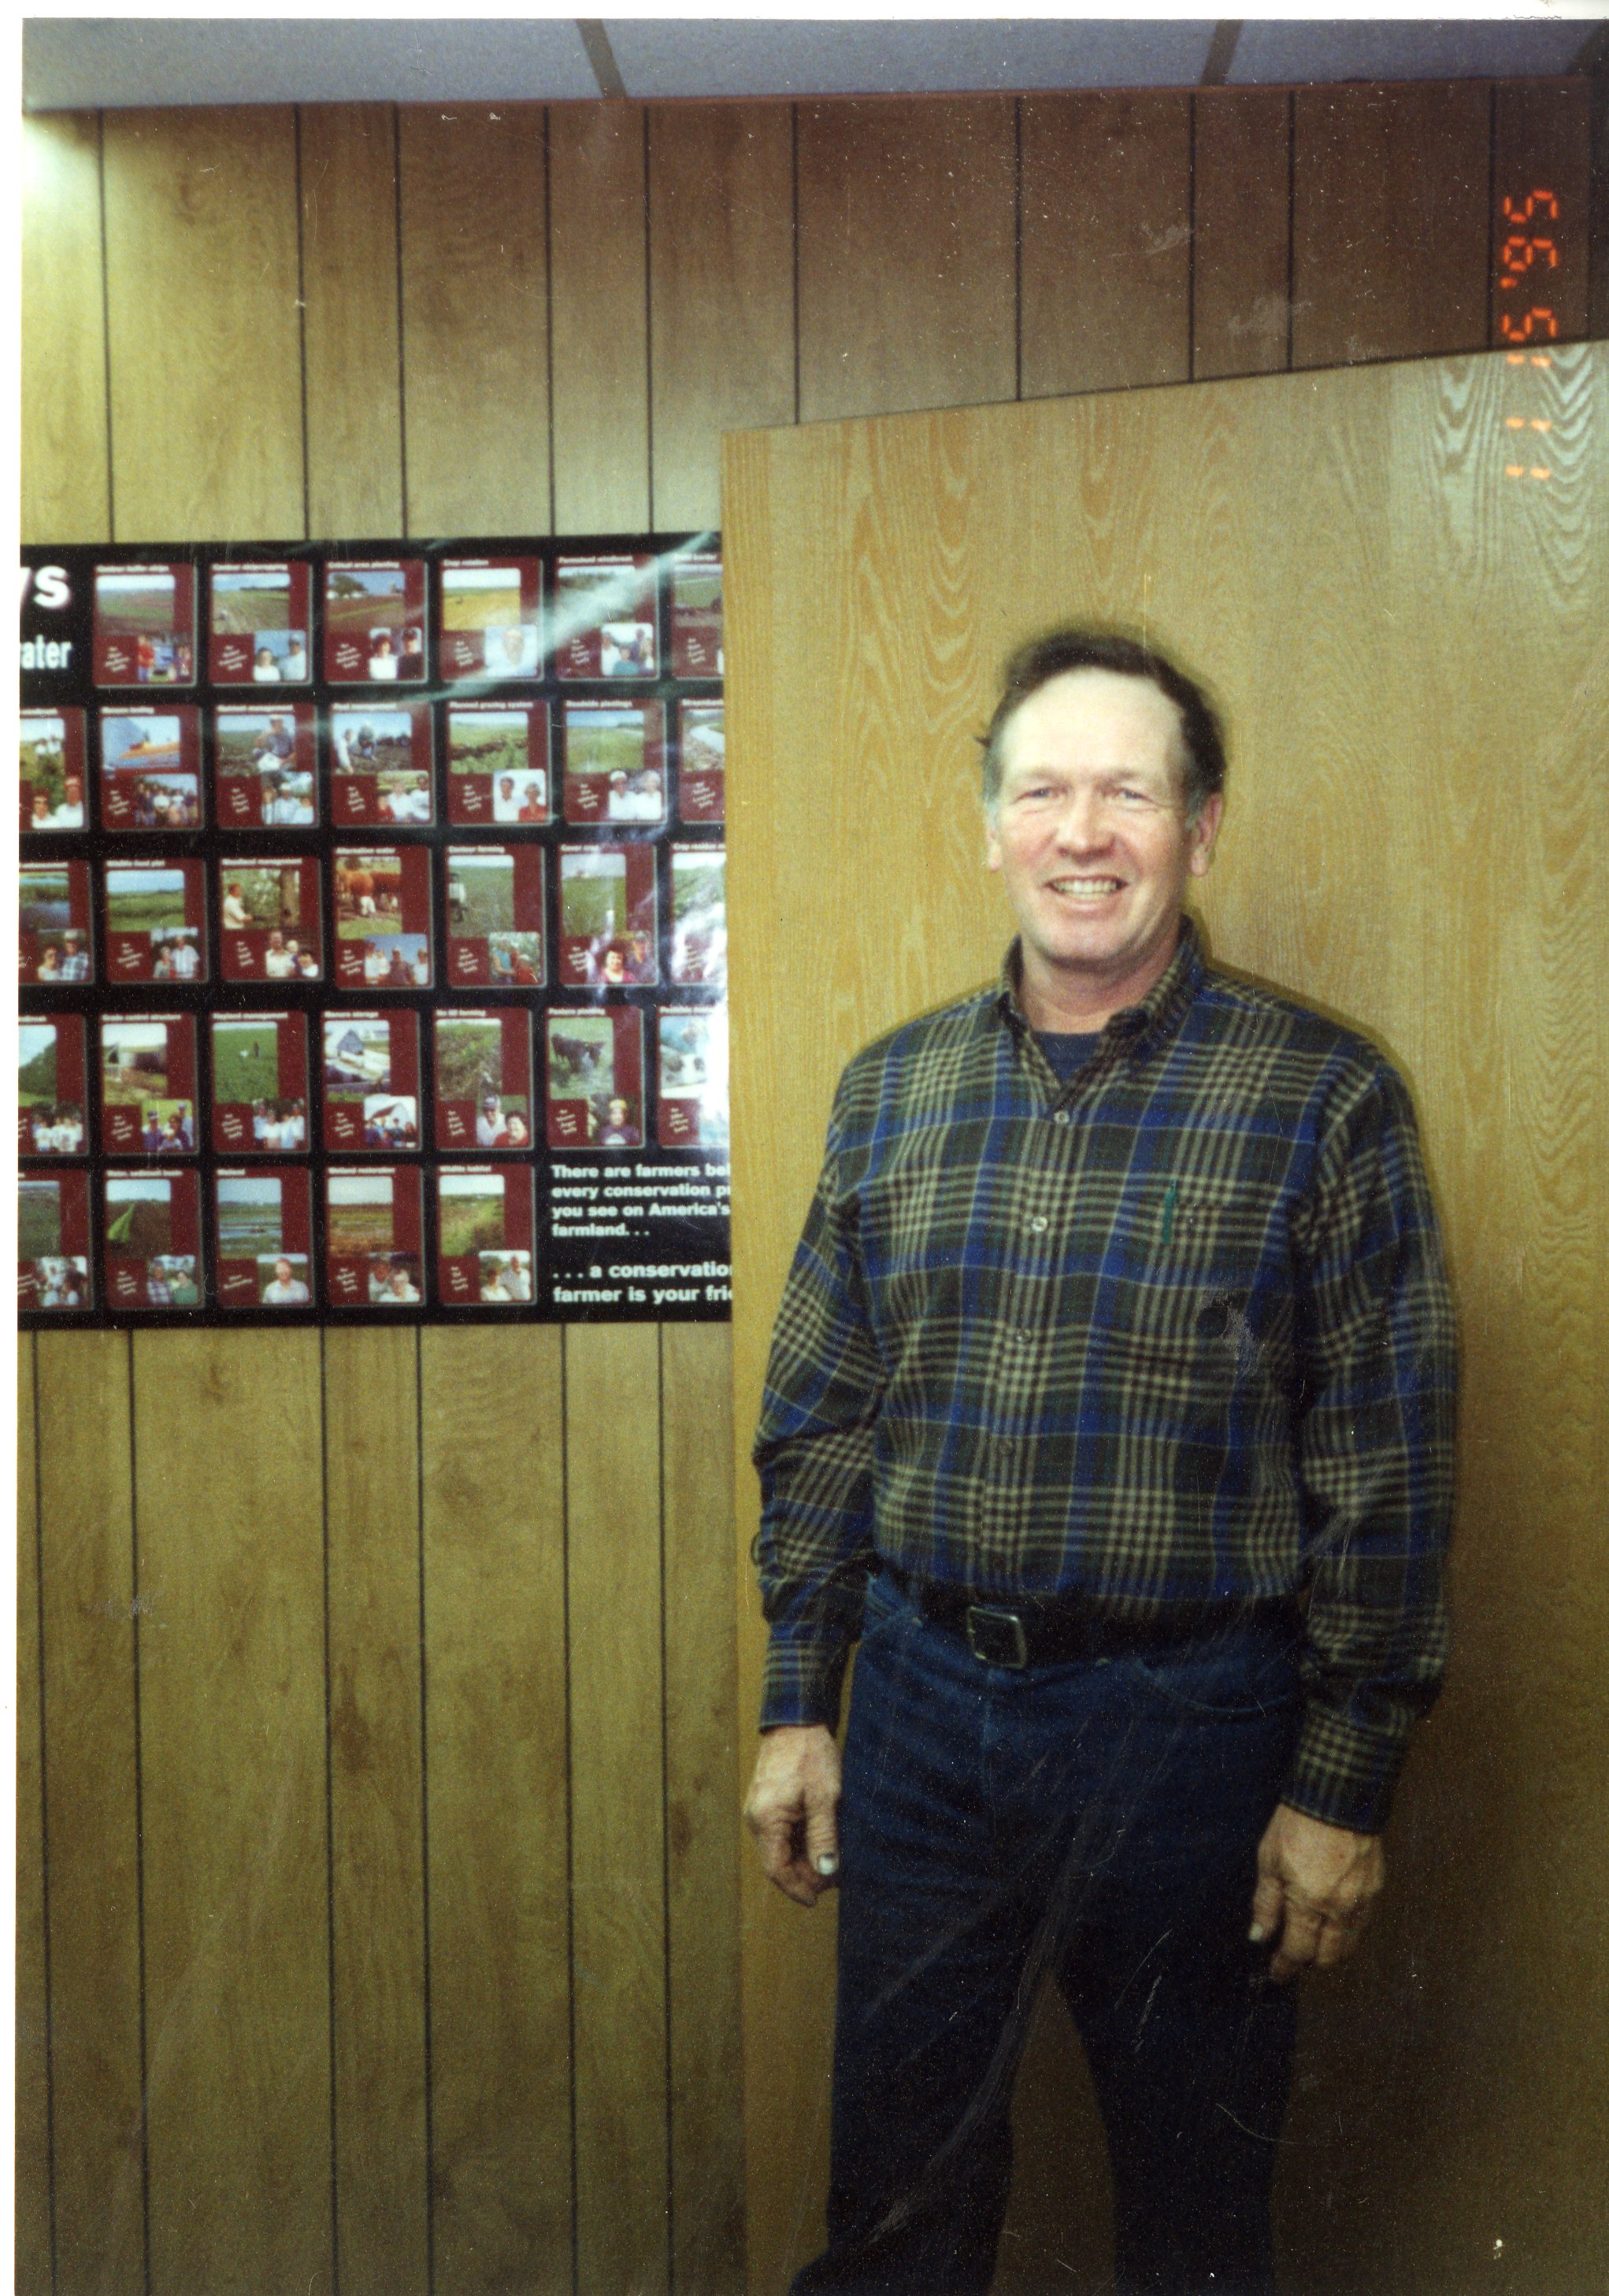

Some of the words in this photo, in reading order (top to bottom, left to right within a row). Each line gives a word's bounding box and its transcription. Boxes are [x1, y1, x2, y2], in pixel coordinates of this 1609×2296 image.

[552, 1165, 599, 1178] There
[603, 1166, 631, 1178] are
[636, 1163, 701, 1178] farmers
[551, 1186, 599, 1199] every
[603, 1183, 710, 1197] conservation
[551, 1205, 583, 1220] you
[588, 1205, 618, 1217] see
[622, 1205, 643, 1217] on
[648, 1202, 731, 1217] America's
[590, 1265, 602, 1279] a
[553, 1287, 622, 1303] farmer
[628, 1287, 646, 1302] is
[652, 1287, 700, 1305] your
